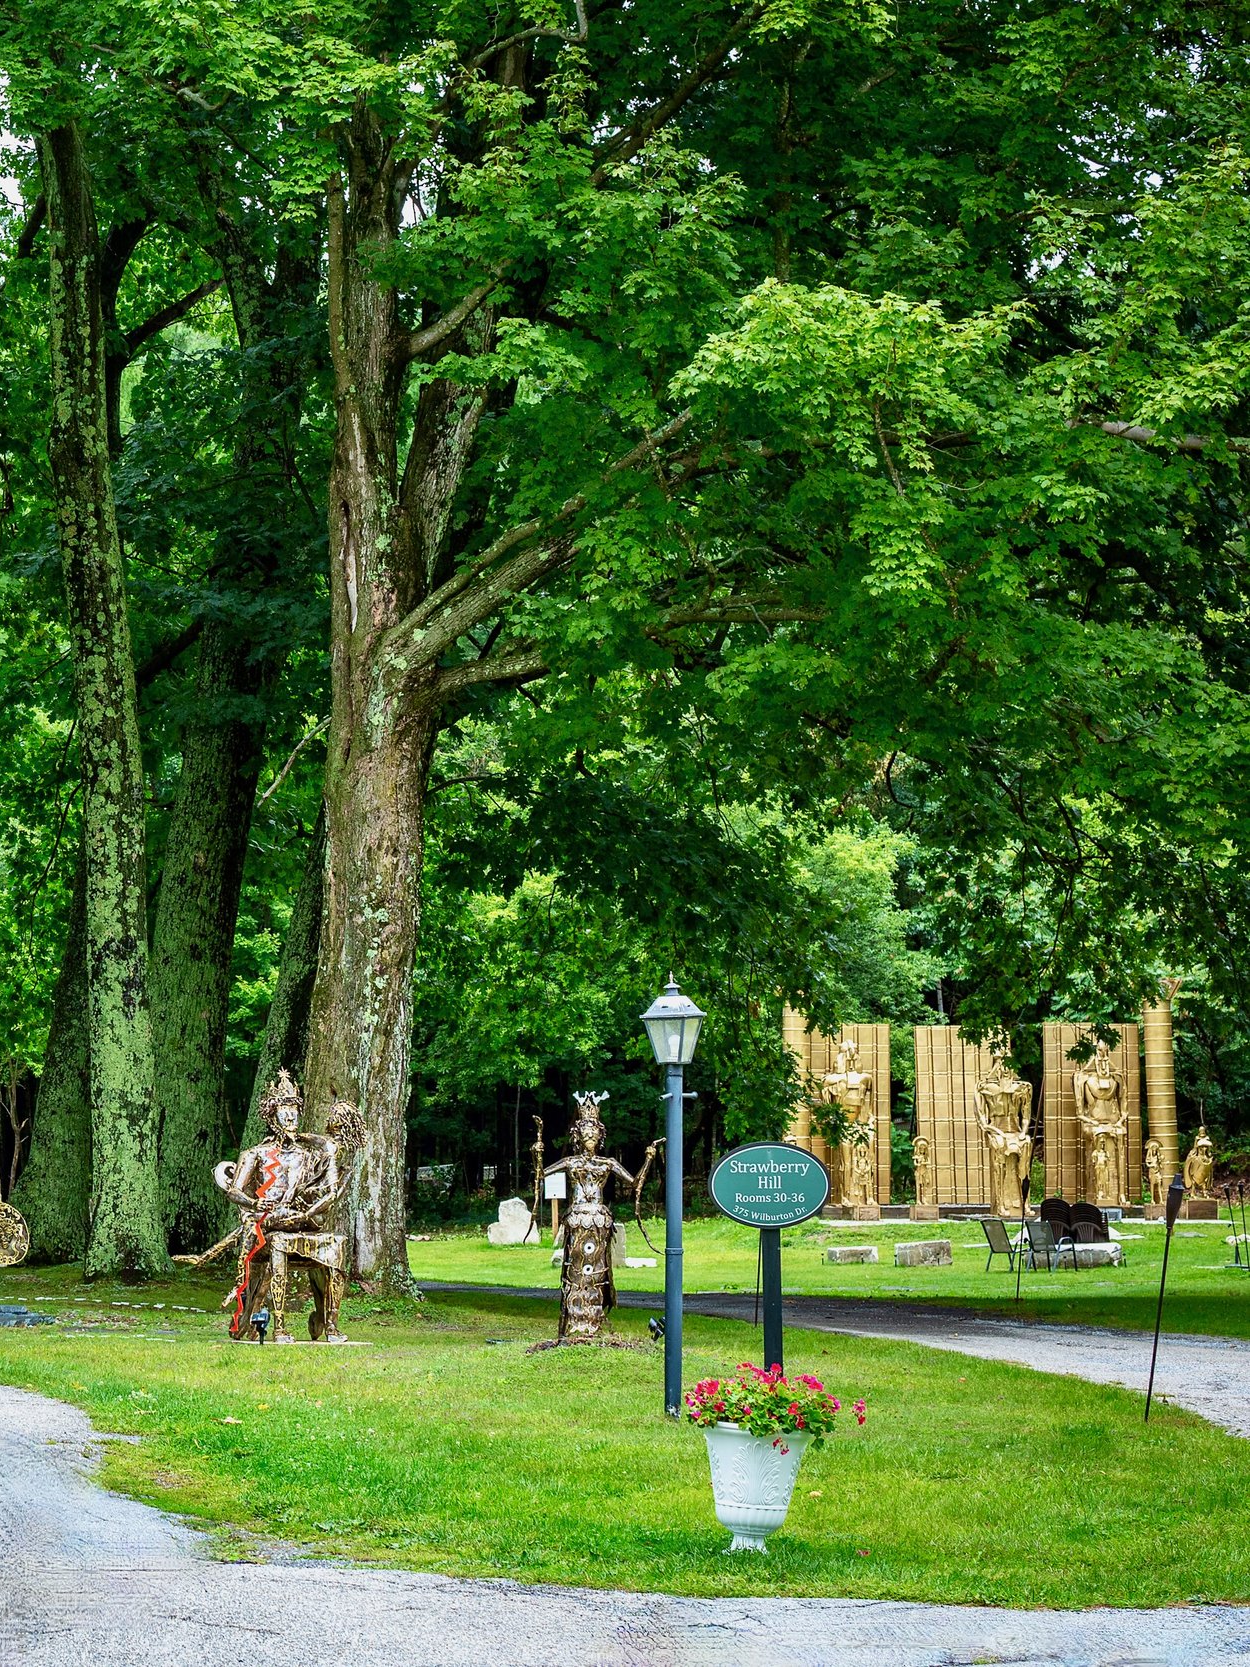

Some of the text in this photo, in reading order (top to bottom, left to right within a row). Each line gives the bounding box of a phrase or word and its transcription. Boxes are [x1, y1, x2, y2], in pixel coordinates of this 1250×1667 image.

[730, 1160, 810, 1176] Strawberry
[757, 1176, 782, 1189] Hill
[735, 1192, 805, 1203] Rooms 30-36
[732, 1205, 808, 1221] 375 Wilburton Dr.
